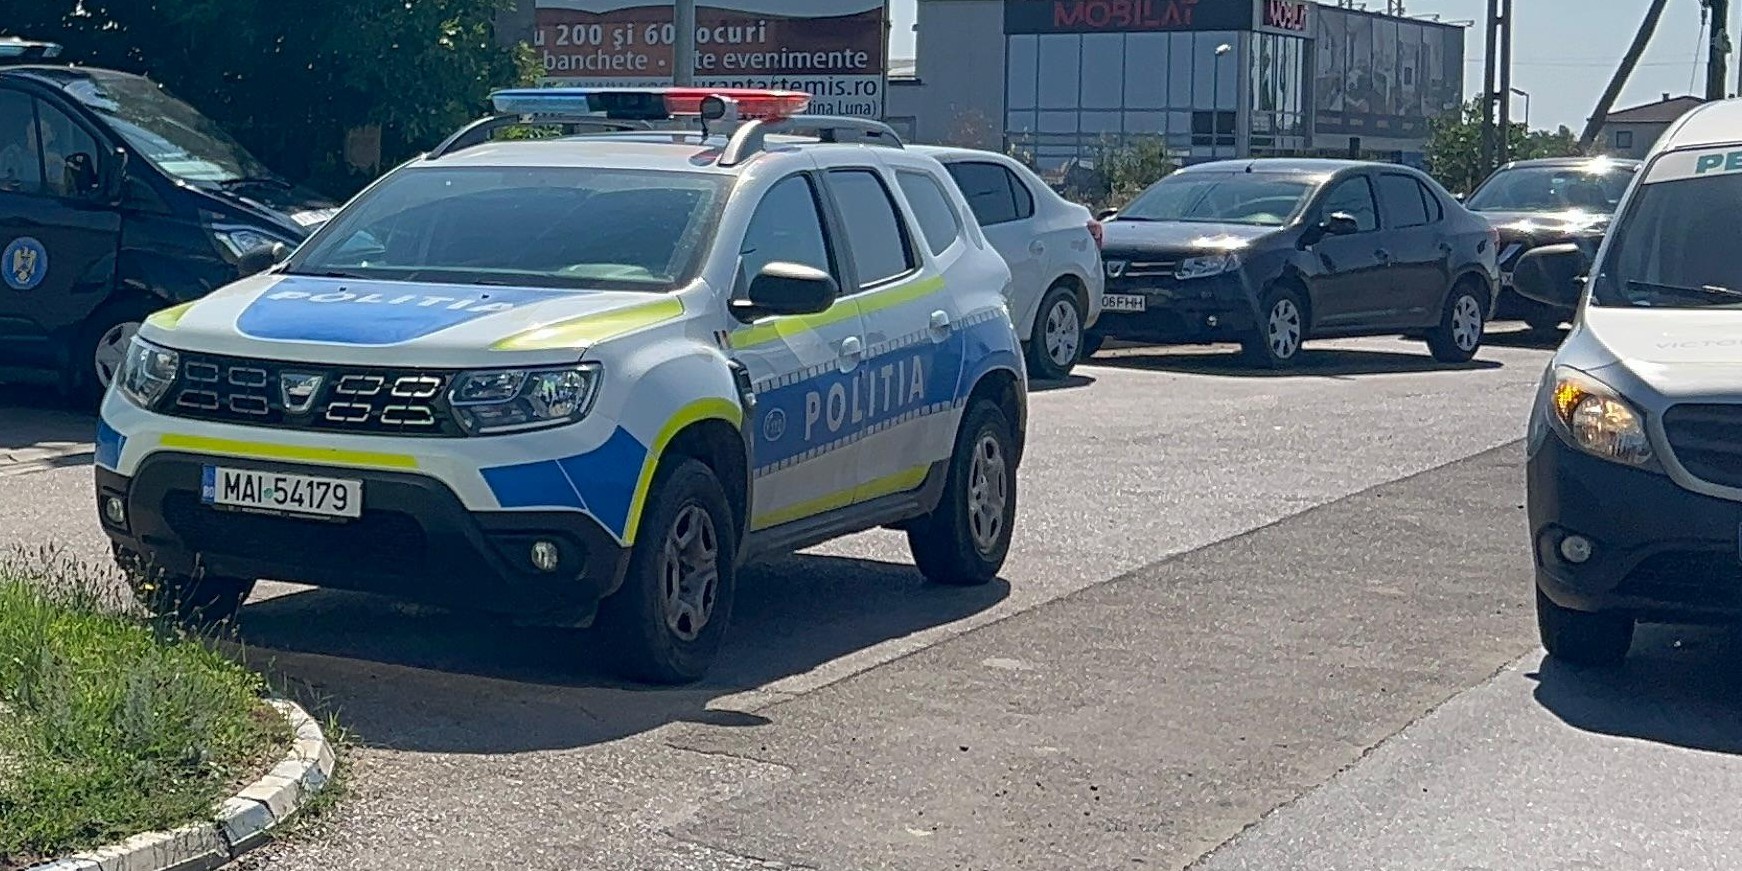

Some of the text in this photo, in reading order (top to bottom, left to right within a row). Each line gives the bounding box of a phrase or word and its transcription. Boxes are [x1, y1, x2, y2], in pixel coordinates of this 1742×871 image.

[1053, 0, 1198, 28] MOBILAT
[555, 24, 602, 46] 200
[644, 23, 675, 45] 60
[695, 20, 767, 44] ocuri
[543, 49, 648, 70] banchete
[722, 48, 868, 69] evenimente
[838, 100, 877, 117] Luna)
[1655, 339, 1742, 350] VICTO
[224, 471, 263, 503] MAI
[273, 477, 348, 512] 54179
